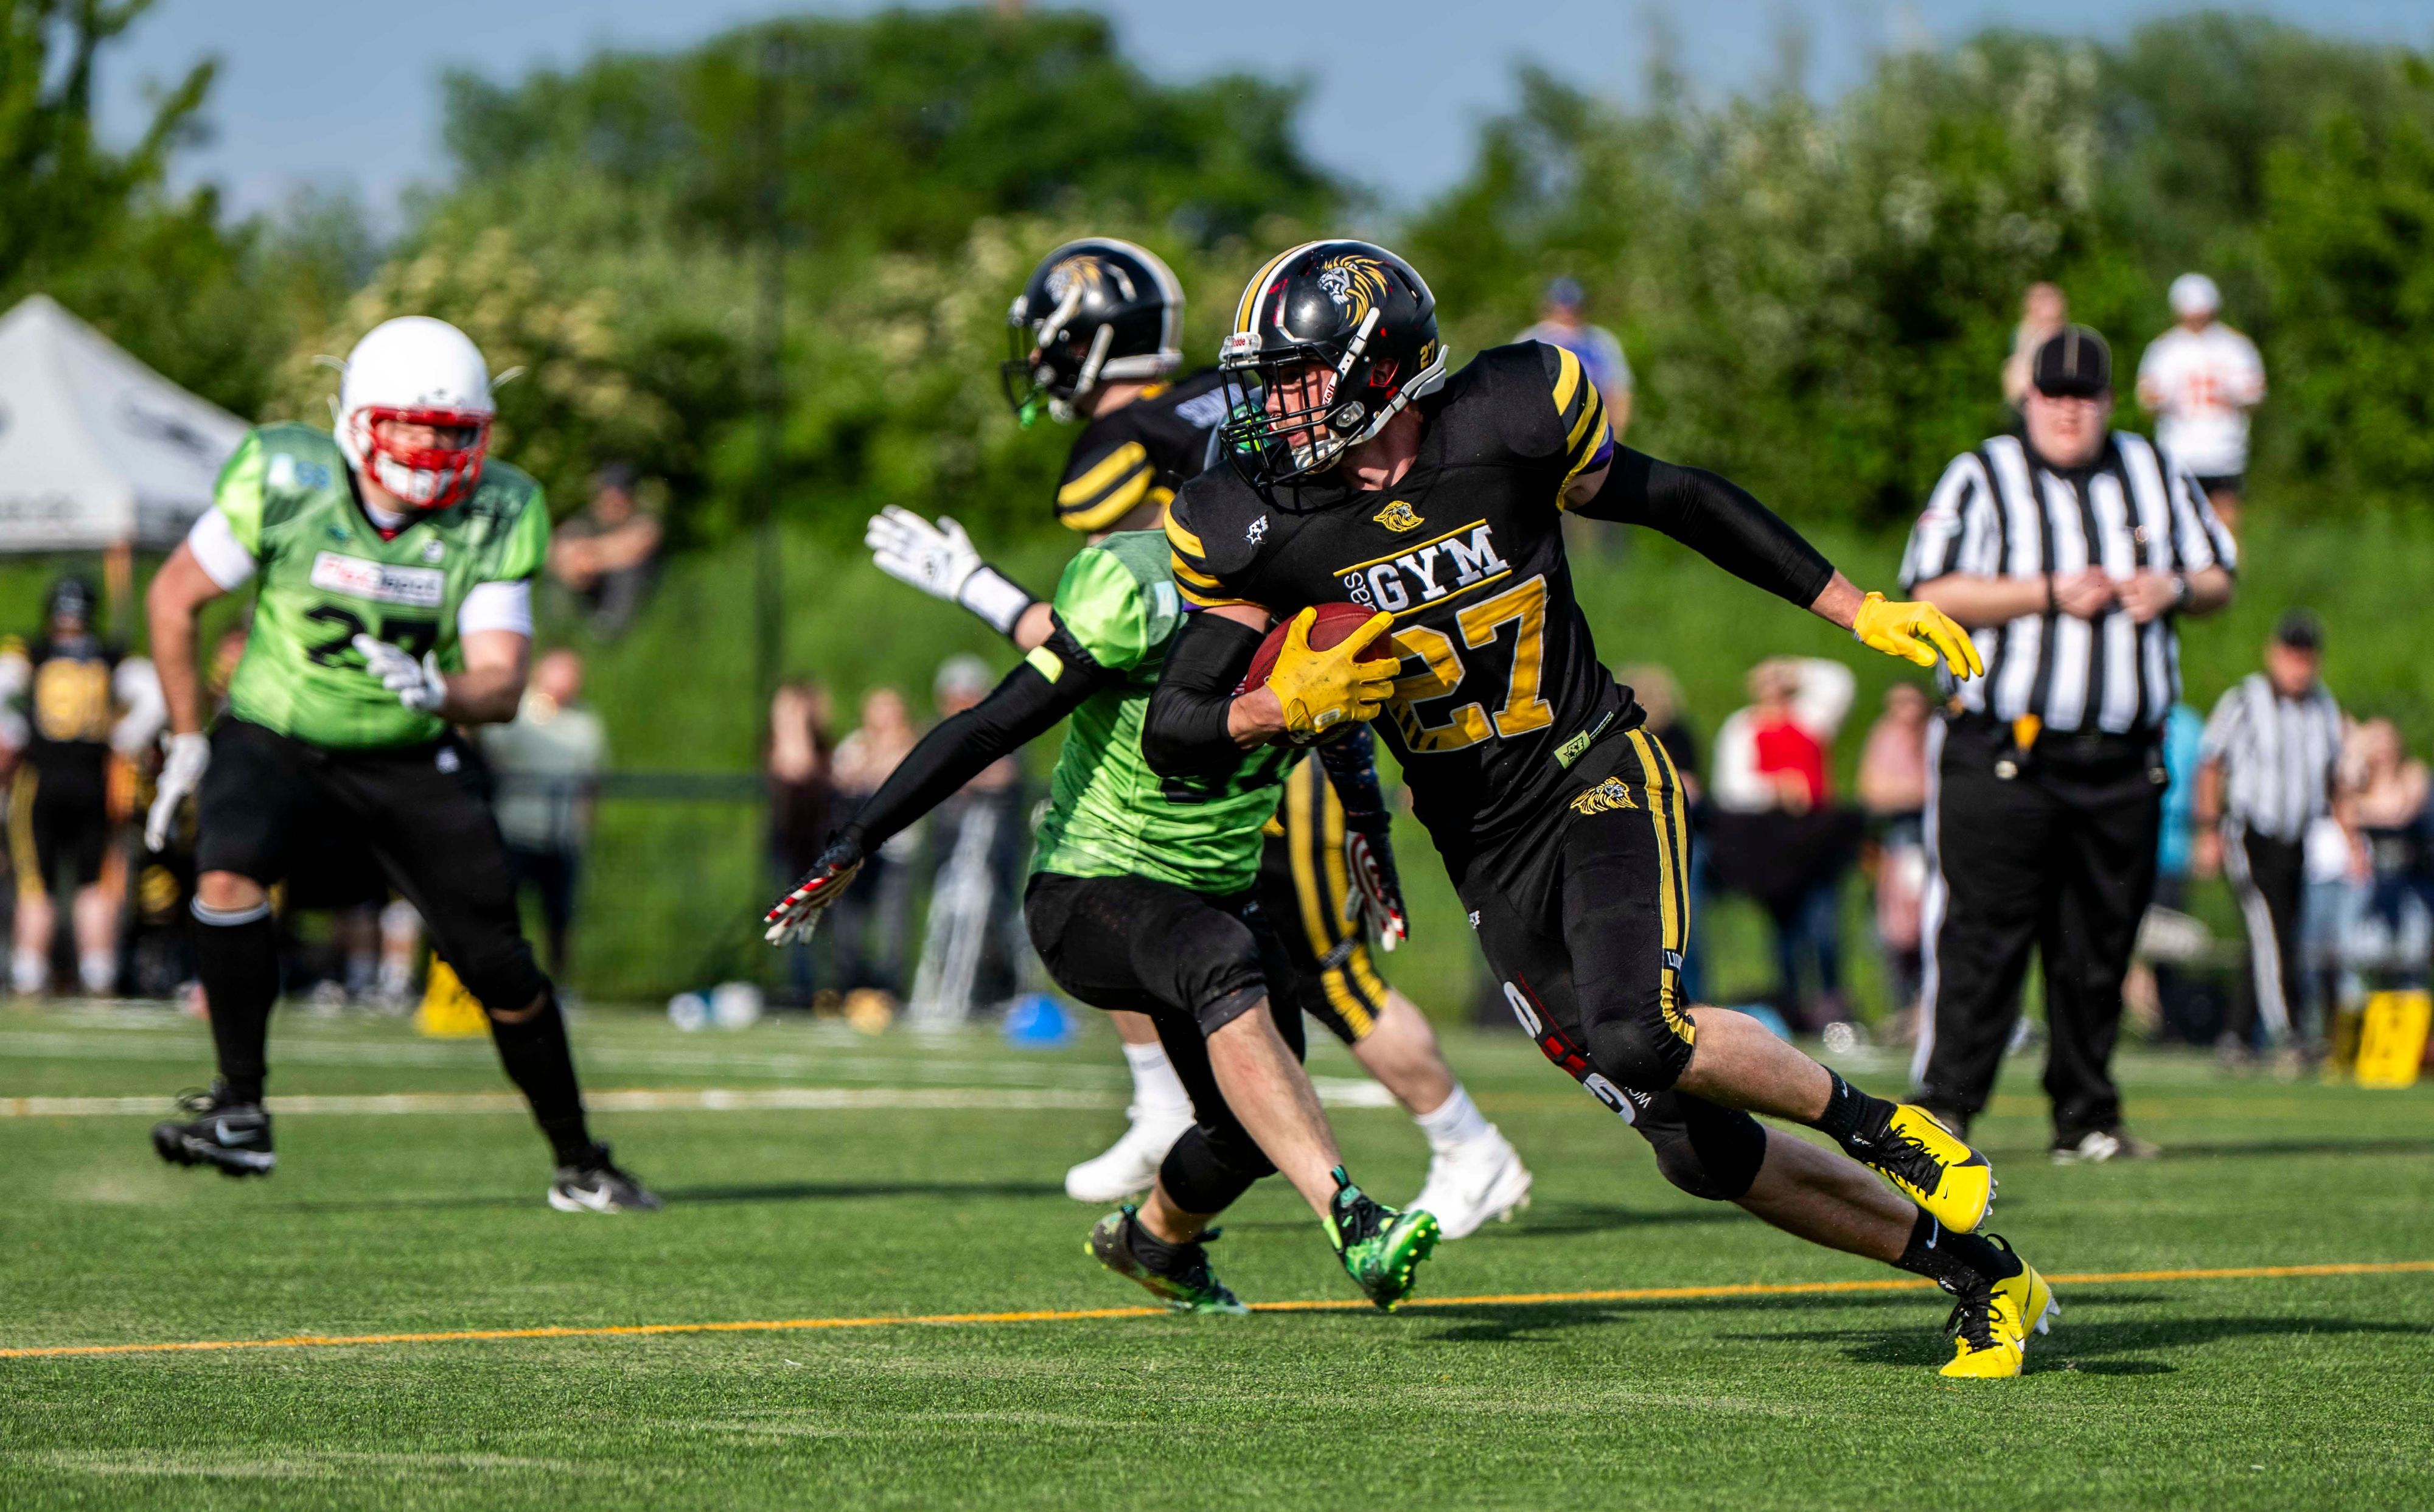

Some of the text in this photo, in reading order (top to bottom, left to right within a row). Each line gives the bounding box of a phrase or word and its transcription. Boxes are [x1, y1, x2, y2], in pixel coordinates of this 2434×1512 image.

[1420, 338, 1435, 369] 27
[1368, 524, 1510, 611] GYM
[1386, 574, 1555, 753] 27
